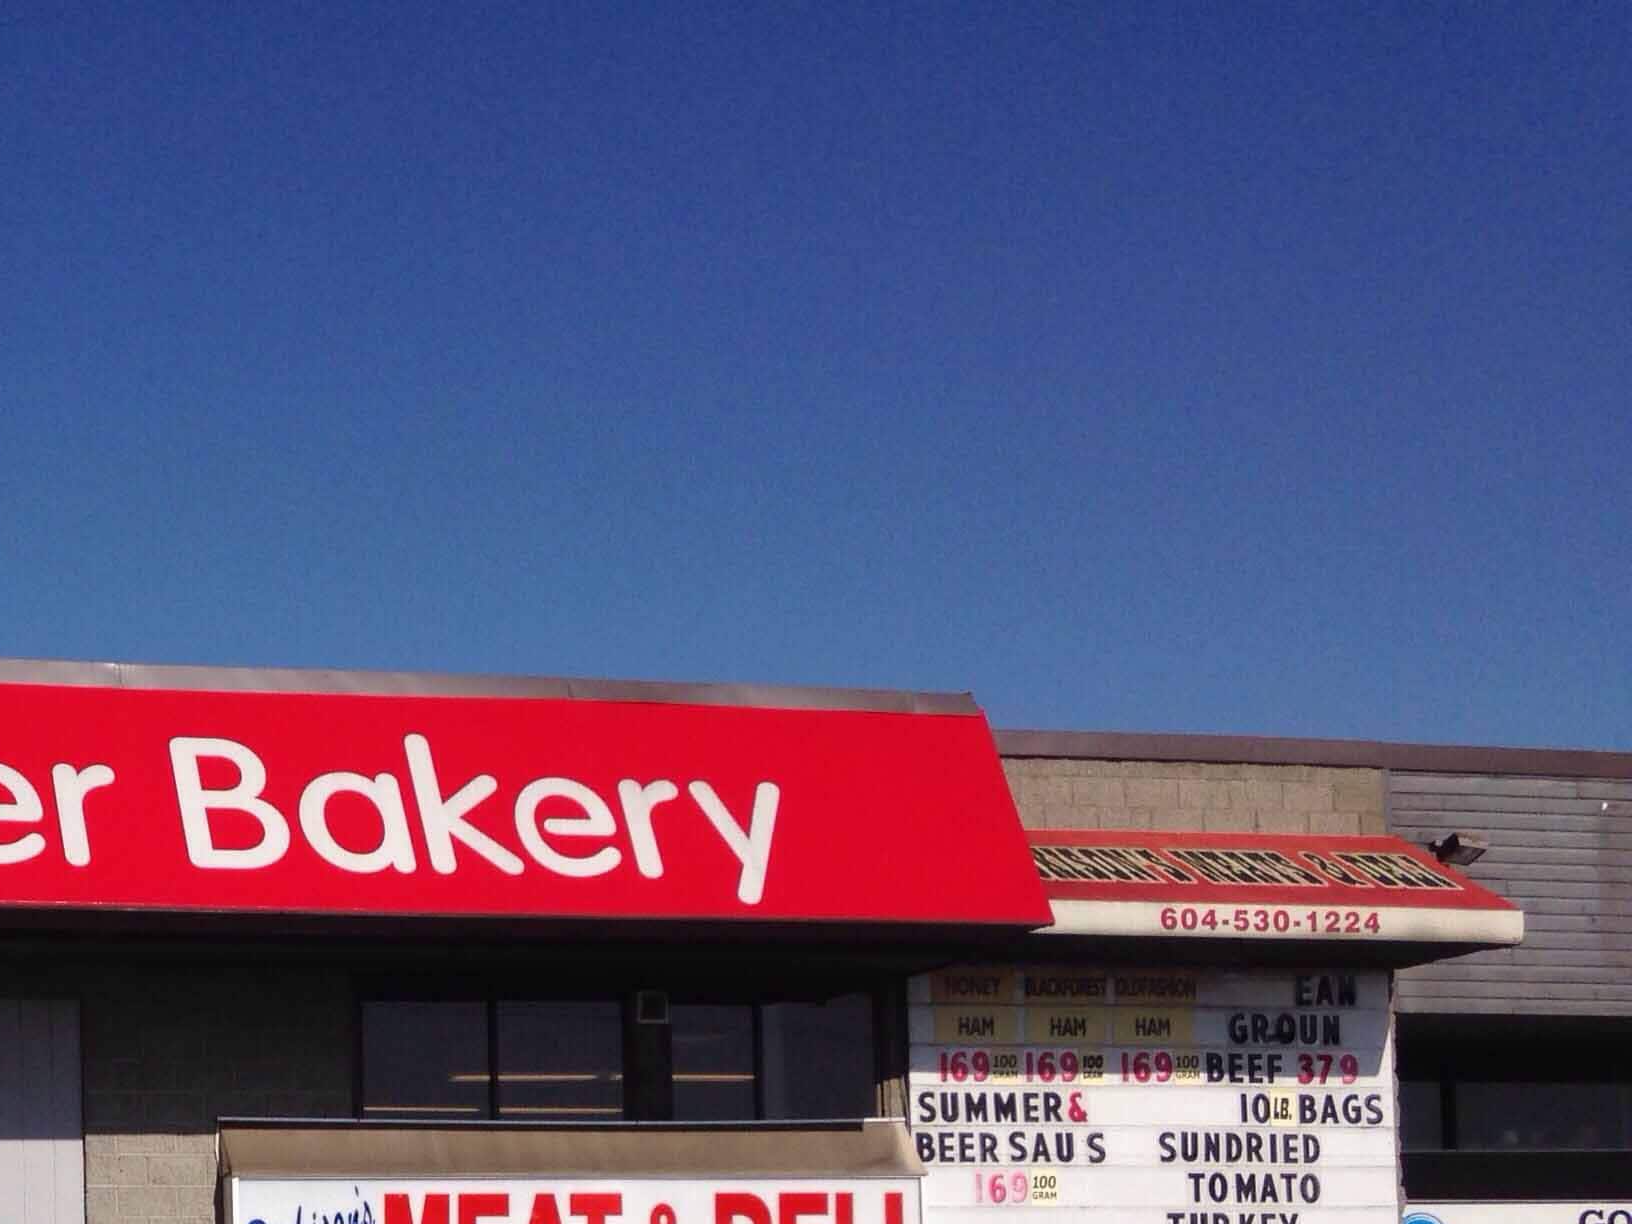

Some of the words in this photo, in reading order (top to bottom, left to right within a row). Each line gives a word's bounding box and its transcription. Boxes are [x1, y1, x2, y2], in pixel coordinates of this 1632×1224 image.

[166, 733, 780, 904] Bakery
[1163, 848, 1327, 886] MEATS
[1300, 851, 1373, 888] &
[1332, 852, 1462, 890] DELI
[1160, 908, 1381, 934] 604-530-1224
[958, 1016, 995, 1037] HAM
[1049, 1017, 1088, 1037] HAM
[1135, 1017, 1171, 1037] HAM
[938, 1051, 990, 1083] 169
[1023, 1051, 1079, 1083] 169
[1121, 1051, 1173, 1083] 169
[1175, 1055, 1200, 1069] 100
[1206, 1052, 1283, 1084] BEEF
[1297, 1053, 1359, 1085] 379
[918, 1091, 1064, 1123] SUMMER
[1298, 1094, 1384, 1125] BAGS
[915, 1132, 1000, 1163] BEER
[1158, 1131, 1320, 1164] SUNDRIED
[975, 1171, 1029, 1204] 169
[1032, 1175, 1057, 1189] 100
[1032, 1191, 1058, 1200] GRAM
[1187, 1172, 1321, 1204] TOMATO
